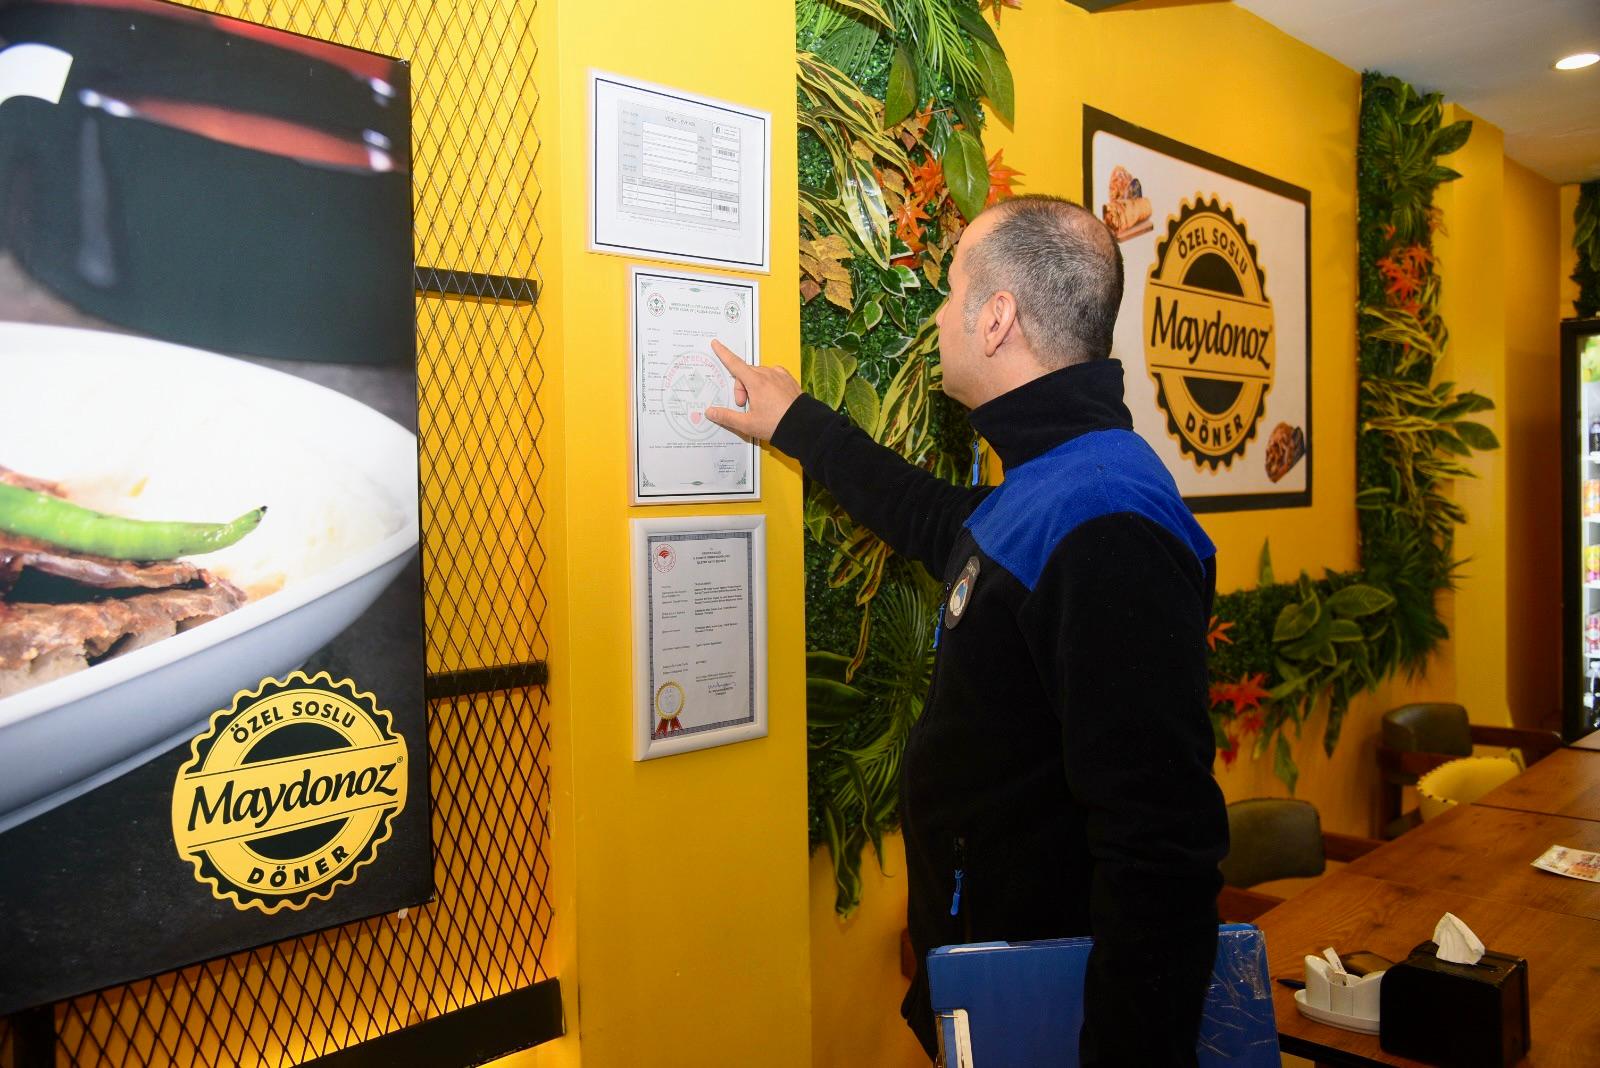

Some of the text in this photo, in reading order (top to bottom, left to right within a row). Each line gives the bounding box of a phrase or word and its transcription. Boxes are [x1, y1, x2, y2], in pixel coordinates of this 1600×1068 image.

[1177, 226, 1248, 275] ÖZEL SOSLU
[1151, 296, 1270, 370] Maydonoz
[1185, 411, 1244, 448] DÖNER
[230, 701, 356, 744] ÖZEL SOSLU
[187, 762, 399, 832] Maydonoz
[247, 845, 350, 888] DÖNER
